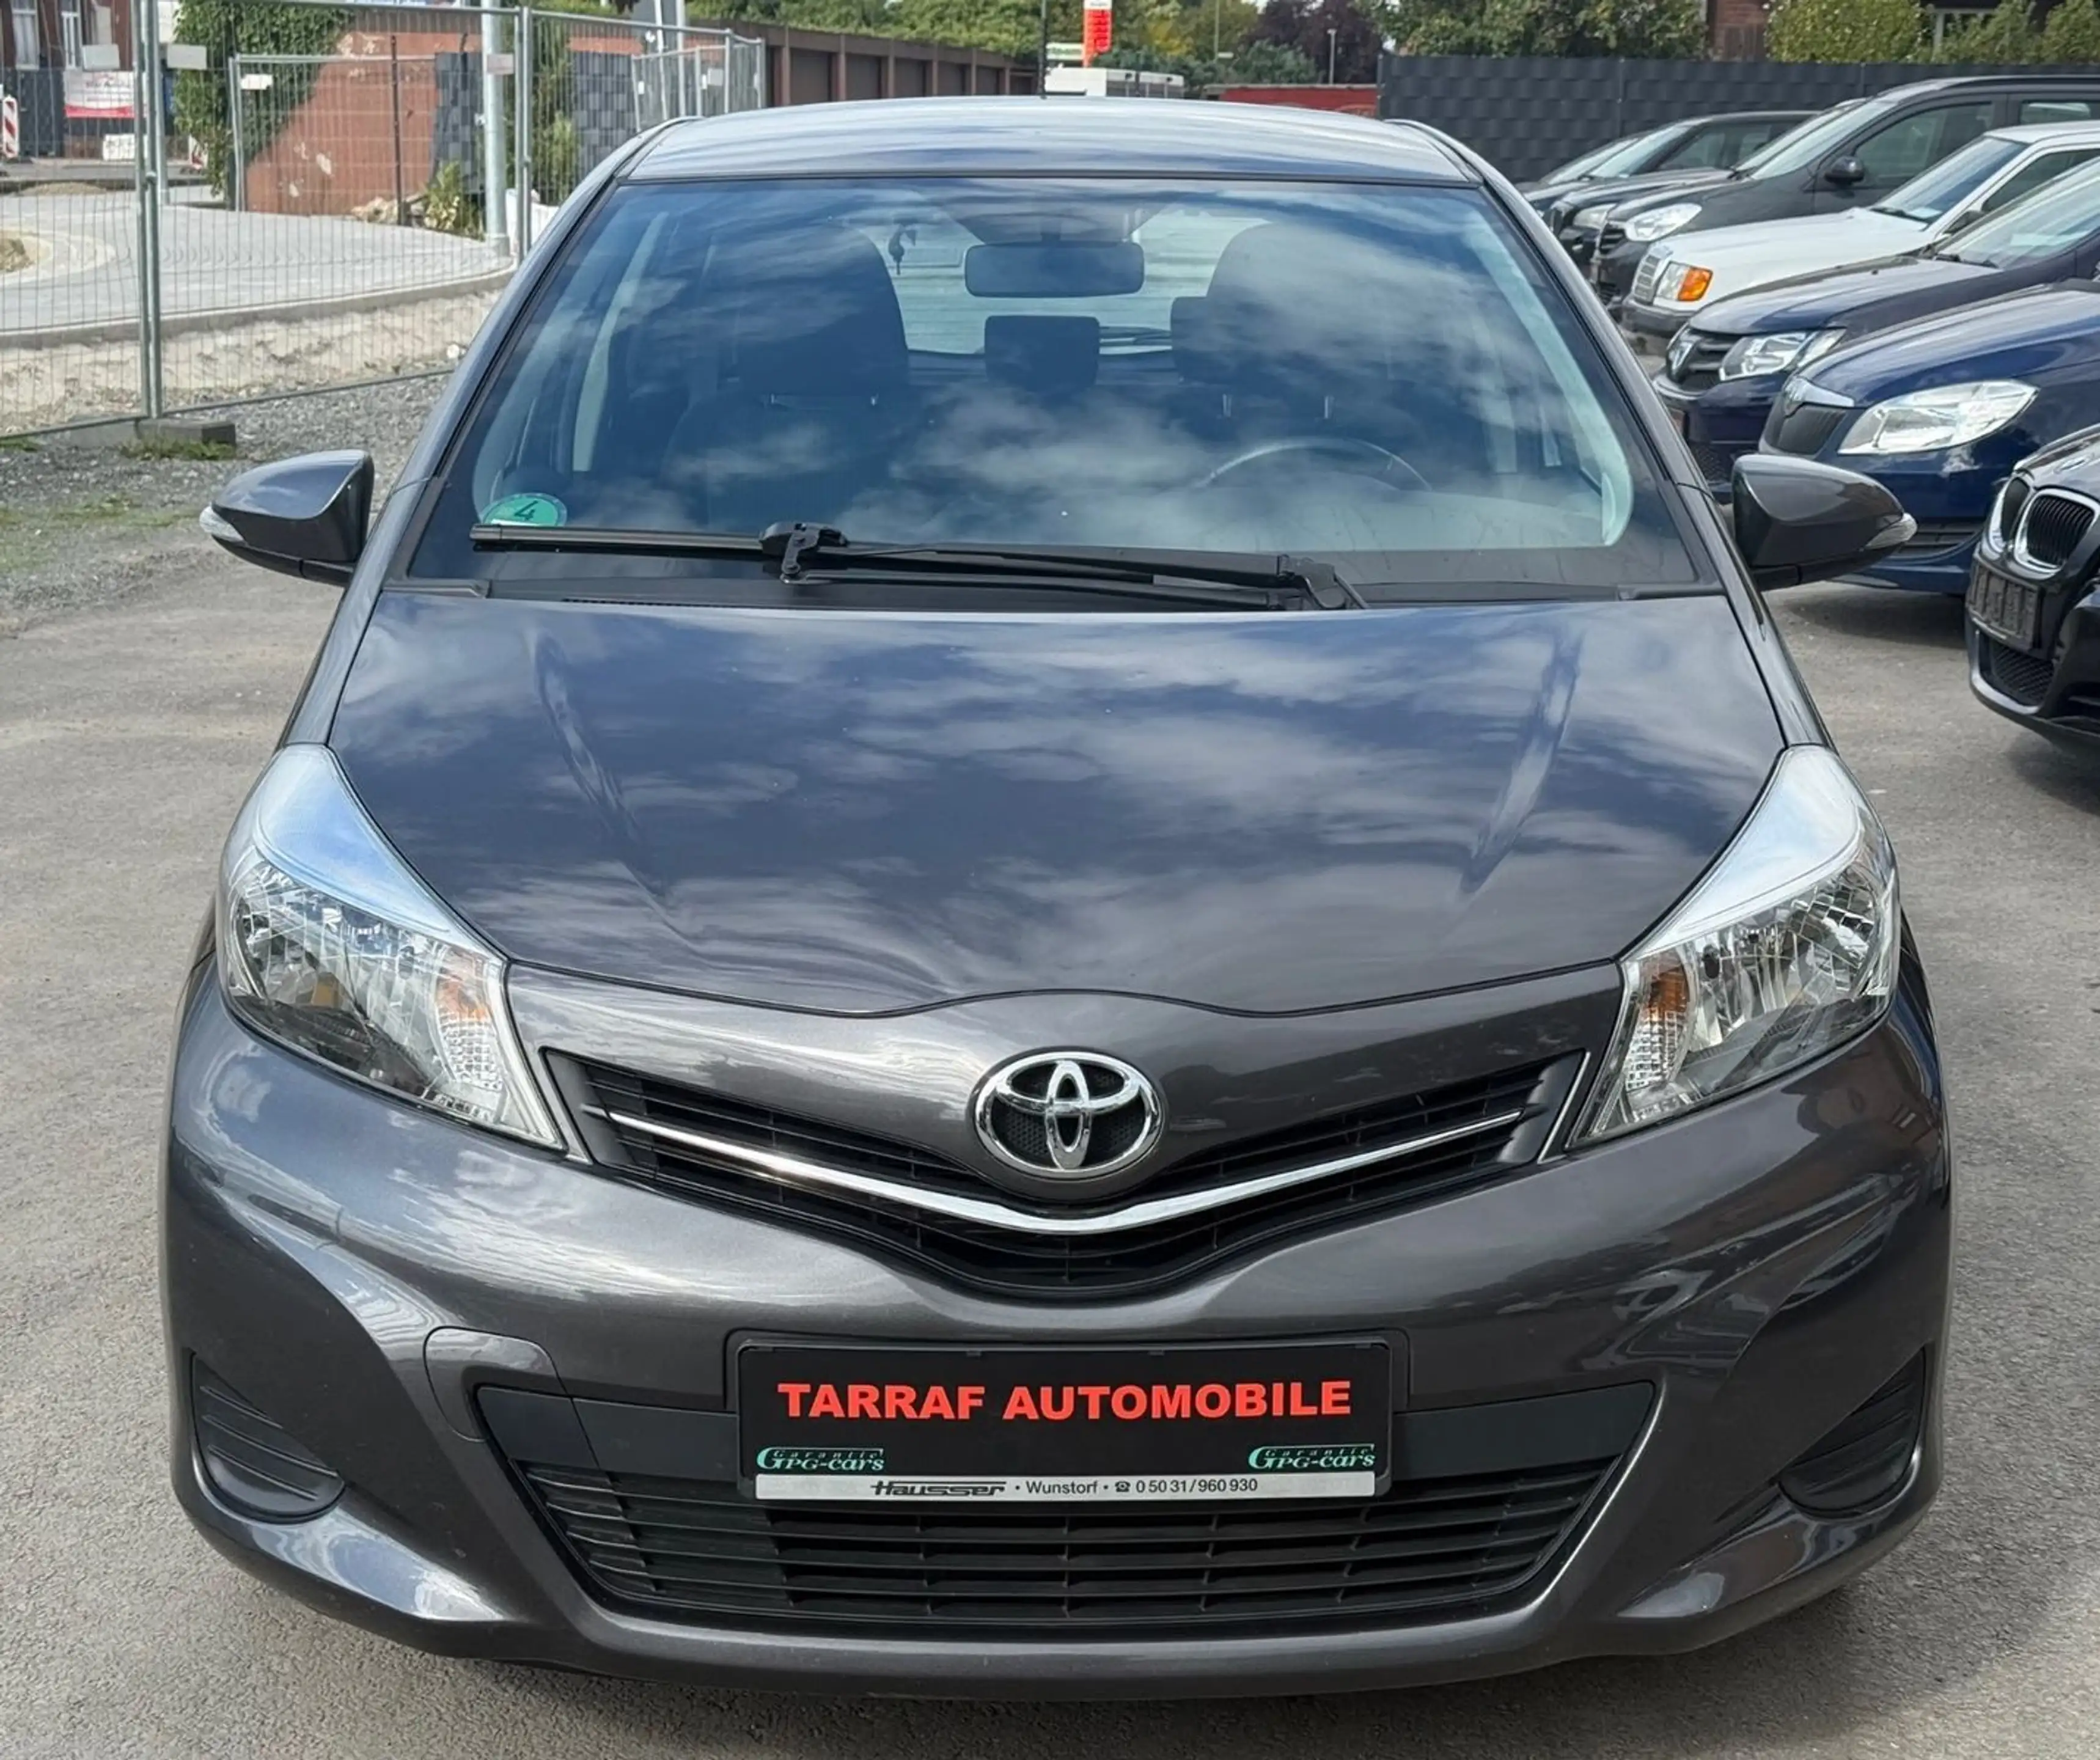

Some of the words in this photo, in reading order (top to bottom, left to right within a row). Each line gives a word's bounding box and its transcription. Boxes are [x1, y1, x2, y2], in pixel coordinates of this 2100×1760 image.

[514, 500, 538, 520] 4
[778, 1382, 985, 1420] TARRAF
[1003, 1380, 1351, 1420] AUTOMOBILE
[870, 1480, 1006, 1496] Hausser
[1026, 1480, 1098, 1494] Wunstorf
